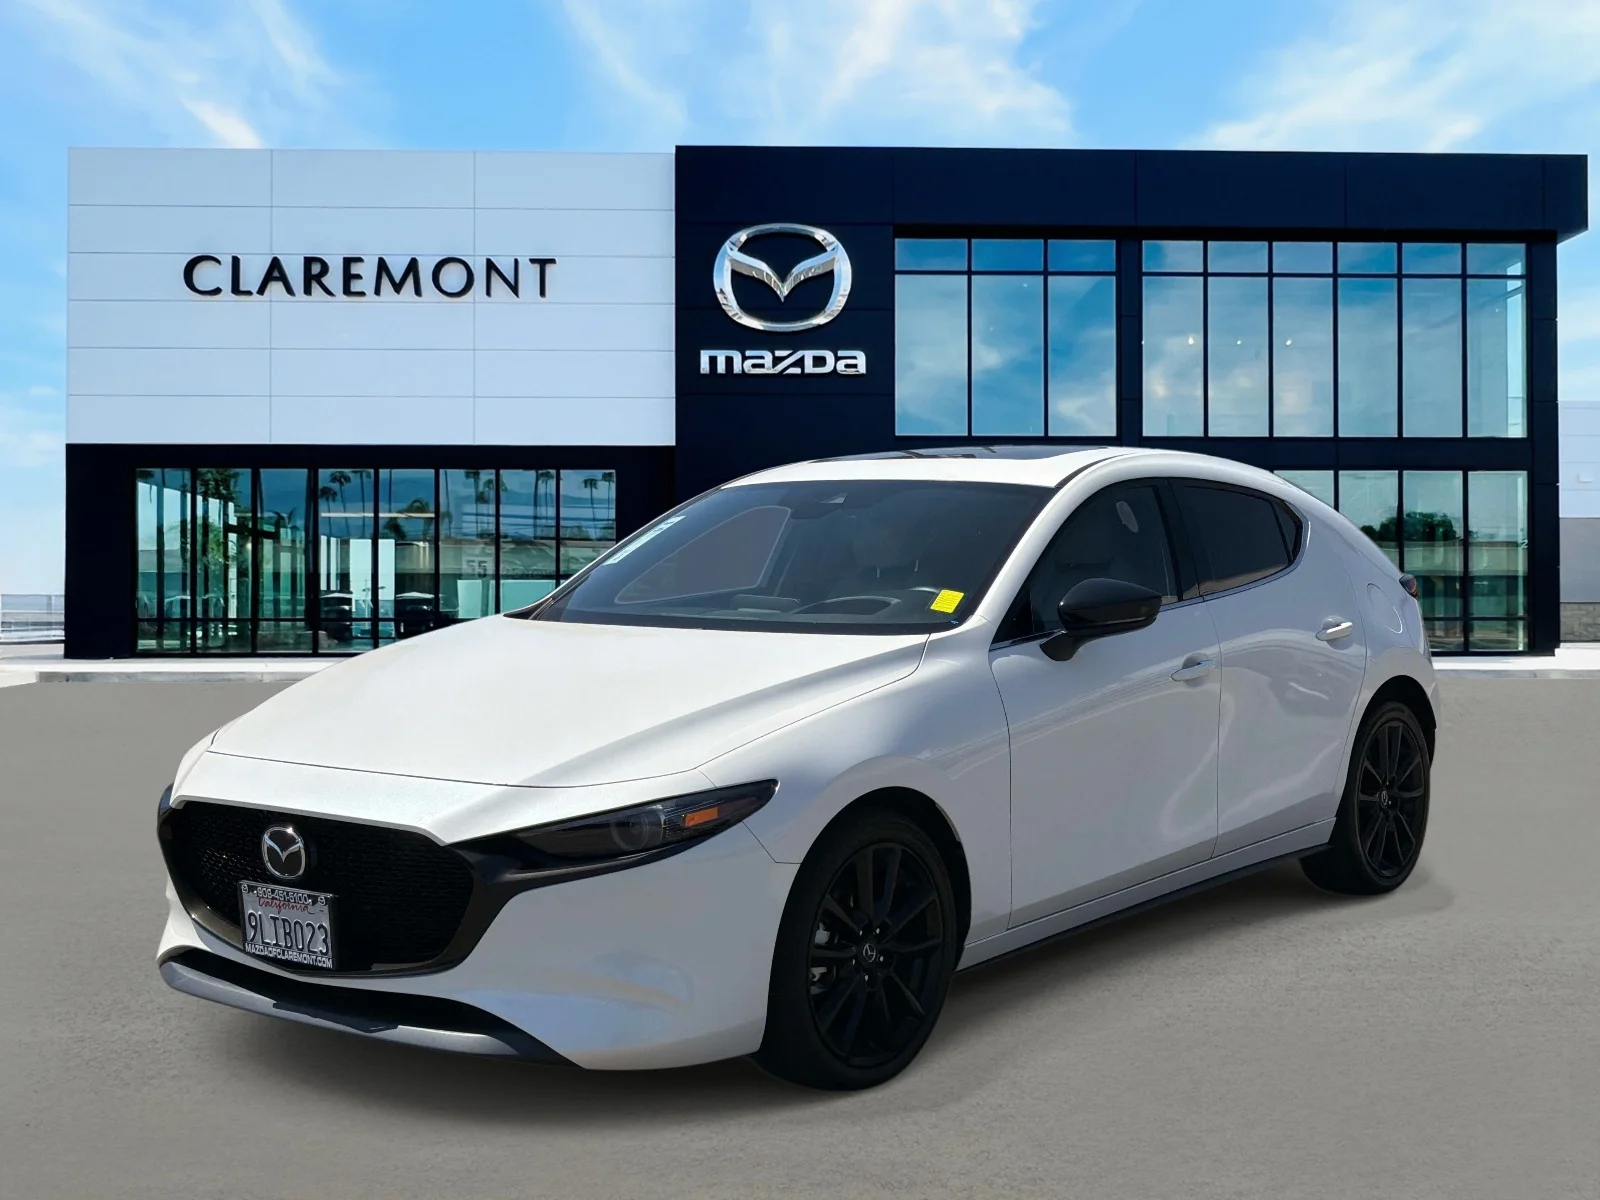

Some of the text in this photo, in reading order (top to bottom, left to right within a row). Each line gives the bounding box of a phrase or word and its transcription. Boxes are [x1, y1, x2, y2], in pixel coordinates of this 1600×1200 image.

[183, 255, 556, 298] CLAREMONT
[247, 911, 329, 955] 9LIB023
[245, 943, 333, 968] MAZDAOFCLAREMONT.COM
